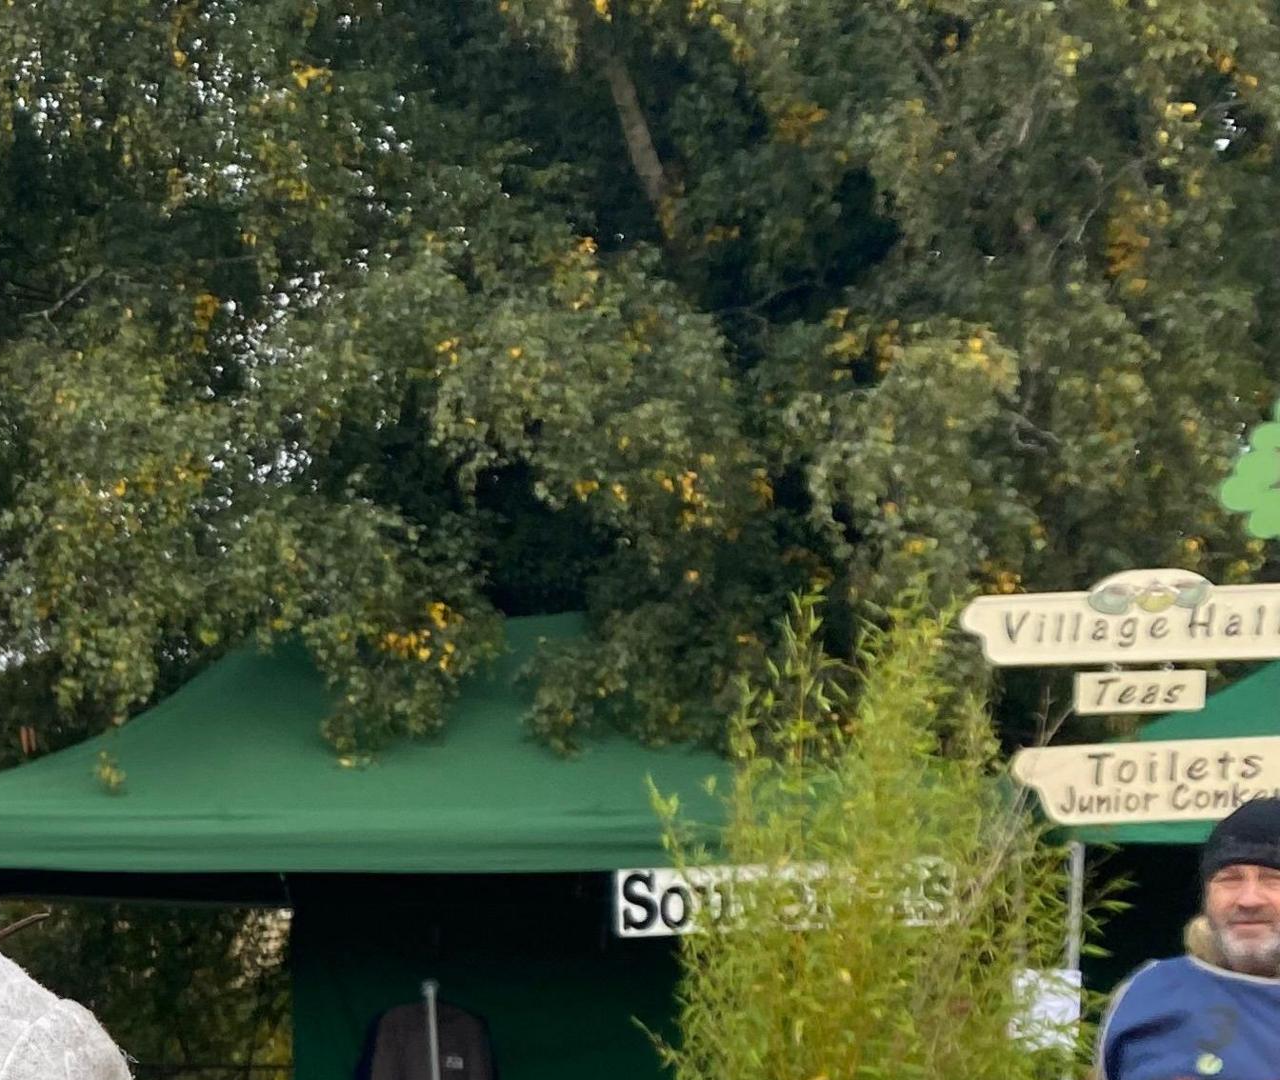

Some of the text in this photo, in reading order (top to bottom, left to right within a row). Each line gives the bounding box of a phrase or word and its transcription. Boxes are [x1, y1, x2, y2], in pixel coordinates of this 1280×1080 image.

[1004, 610, 1171, 648] Village
[1096, 676, 1187, 706] Teas
[1087, 751, 1264, 786] Toilets
[1060, 785, 1160, 815] Junior
